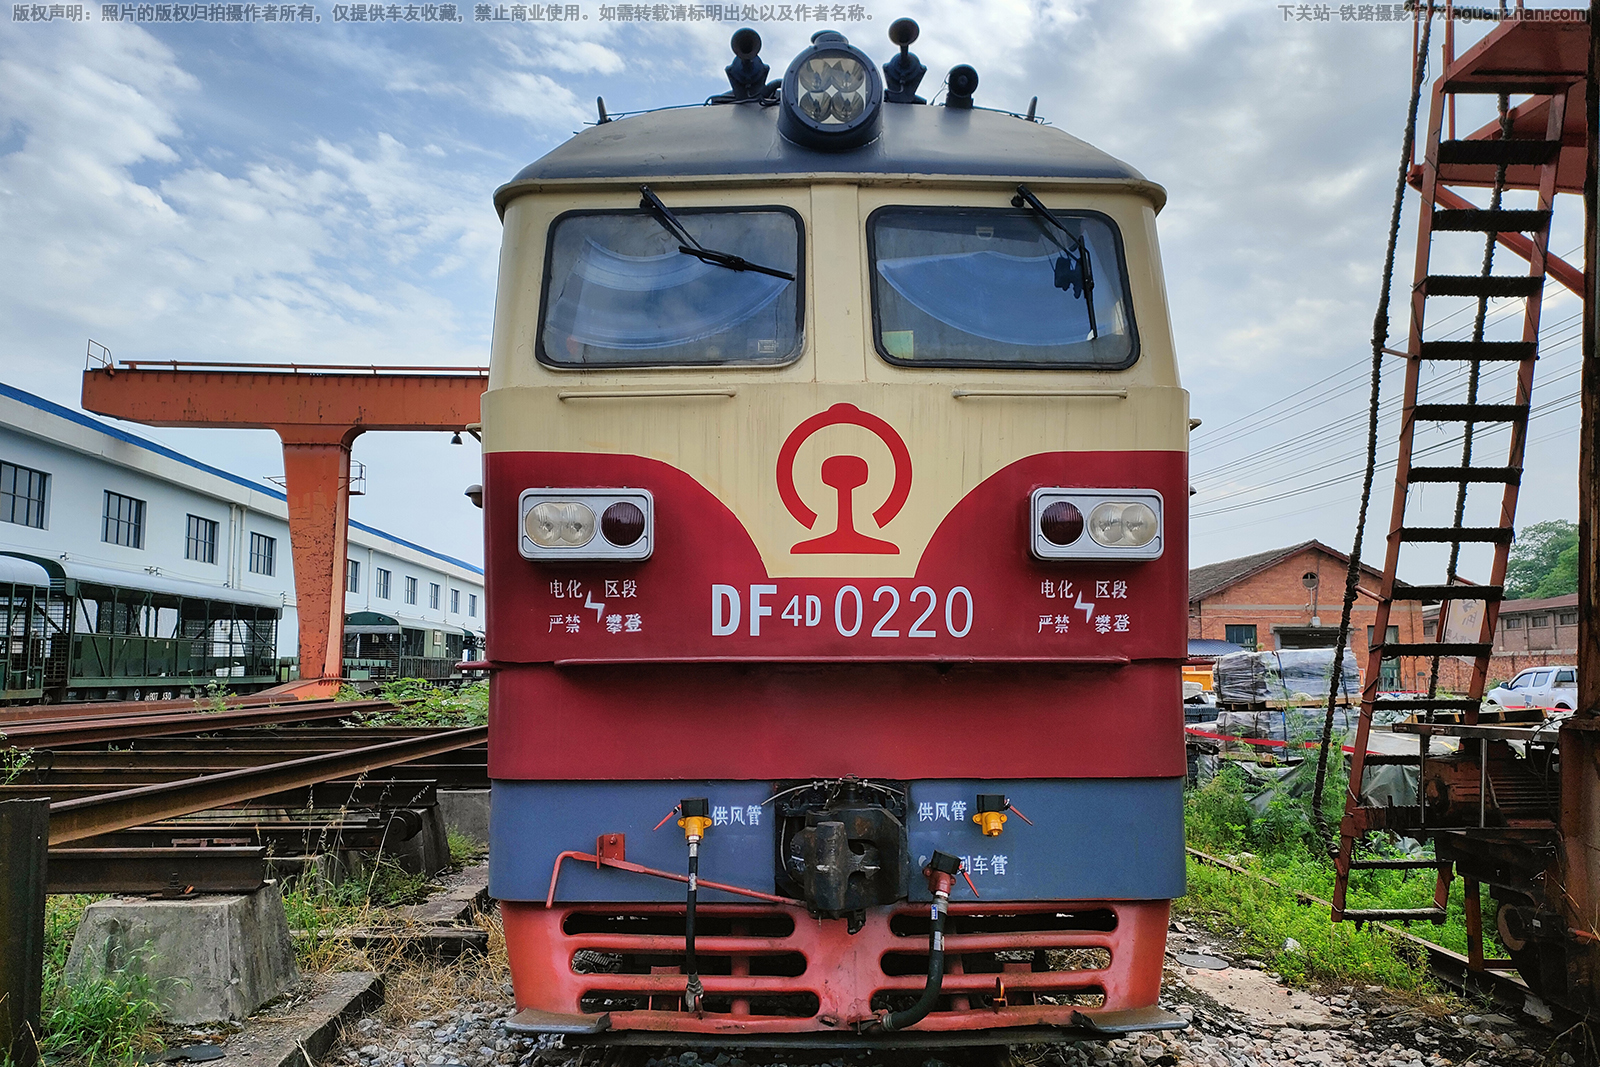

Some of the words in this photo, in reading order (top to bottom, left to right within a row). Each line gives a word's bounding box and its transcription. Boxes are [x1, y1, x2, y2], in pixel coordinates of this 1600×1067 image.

[549, 579, 583, 599] 电化
[604, 579, 638, 598] 区段
[1040, 579, 1074, 599] 电化
[1095, 579, 1128, 599] 区段
[834, 585, 974, 638] 0220
[548, 613, 581, 633] 严禁
[605, 613, 642, 634] 攀登
[1037, 614, 1070, 634] 严禁
[1095, 613, 1130, 634] 攀登
[711, 805, 762, 826] 供风管
[917, 800, 967, 822] 供风管
